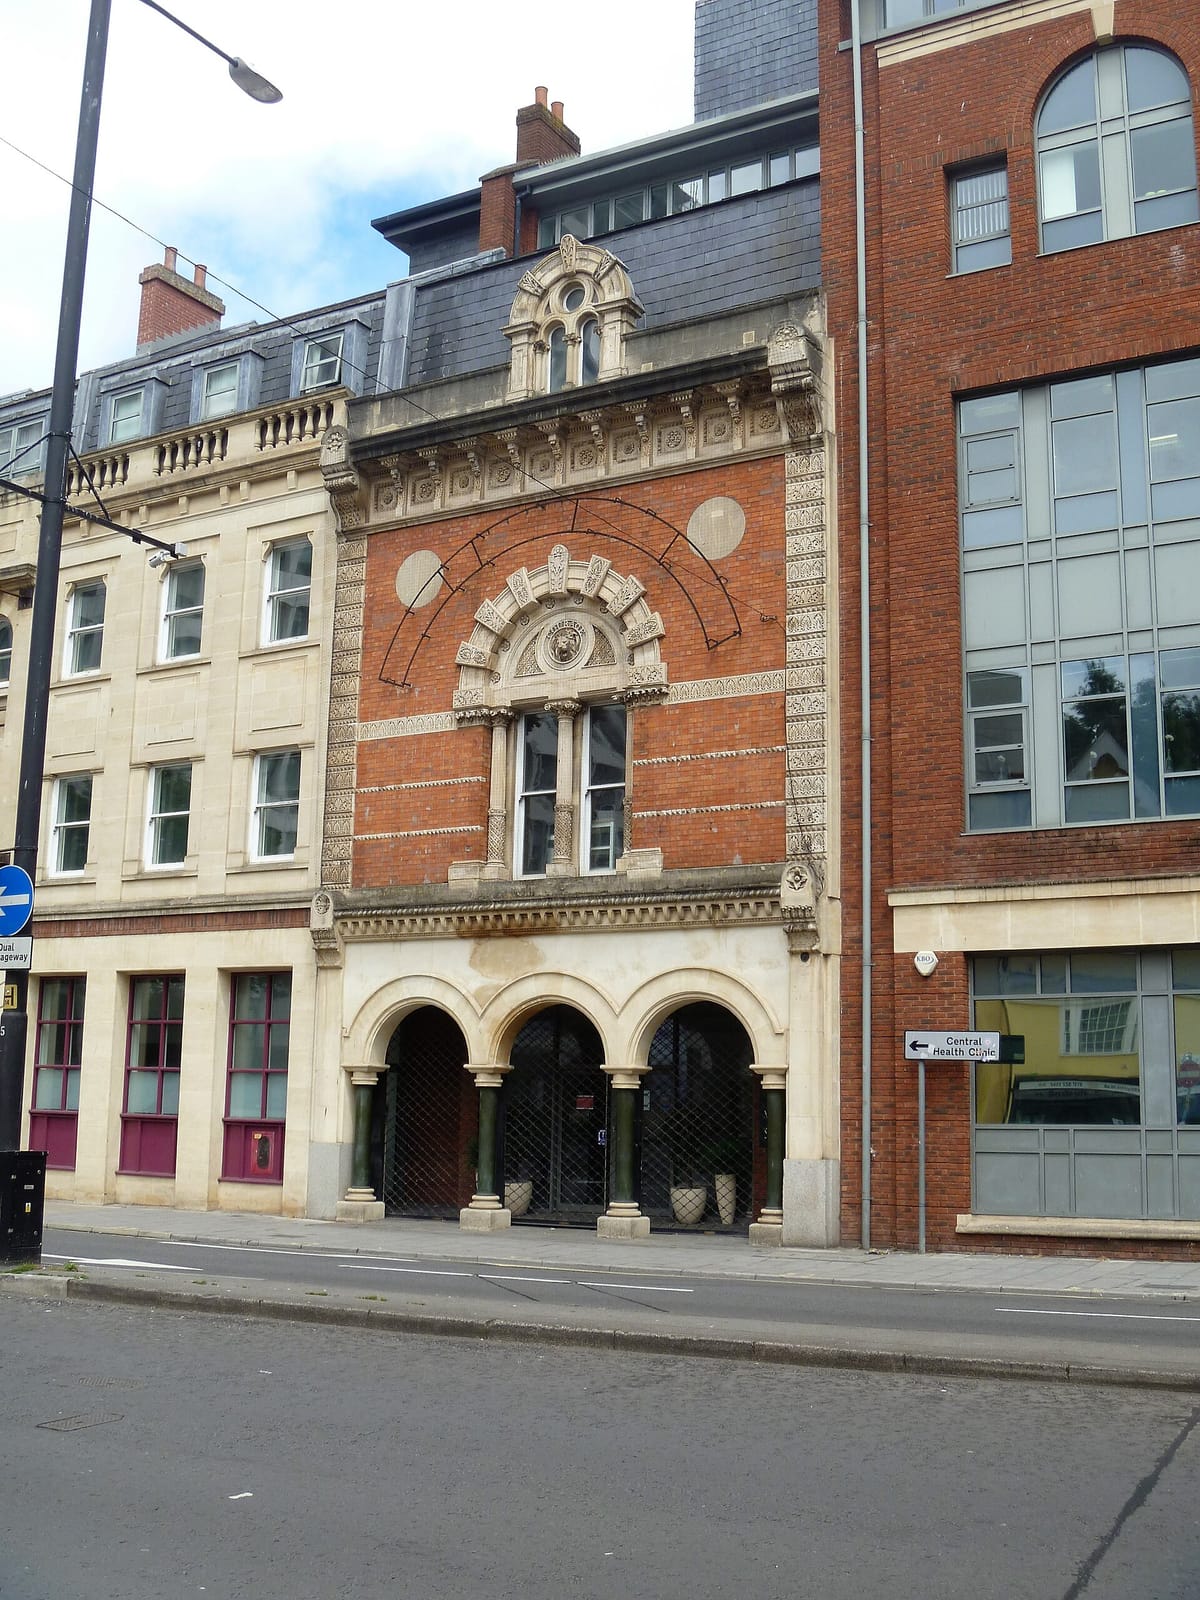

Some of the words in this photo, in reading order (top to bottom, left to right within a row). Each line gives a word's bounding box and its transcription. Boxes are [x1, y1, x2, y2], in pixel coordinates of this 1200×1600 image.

[946, 1037, 982, 1046] Central
[933, 1048, 965, 1057] Health
[968, 1048, 996, 1057] Clinic
